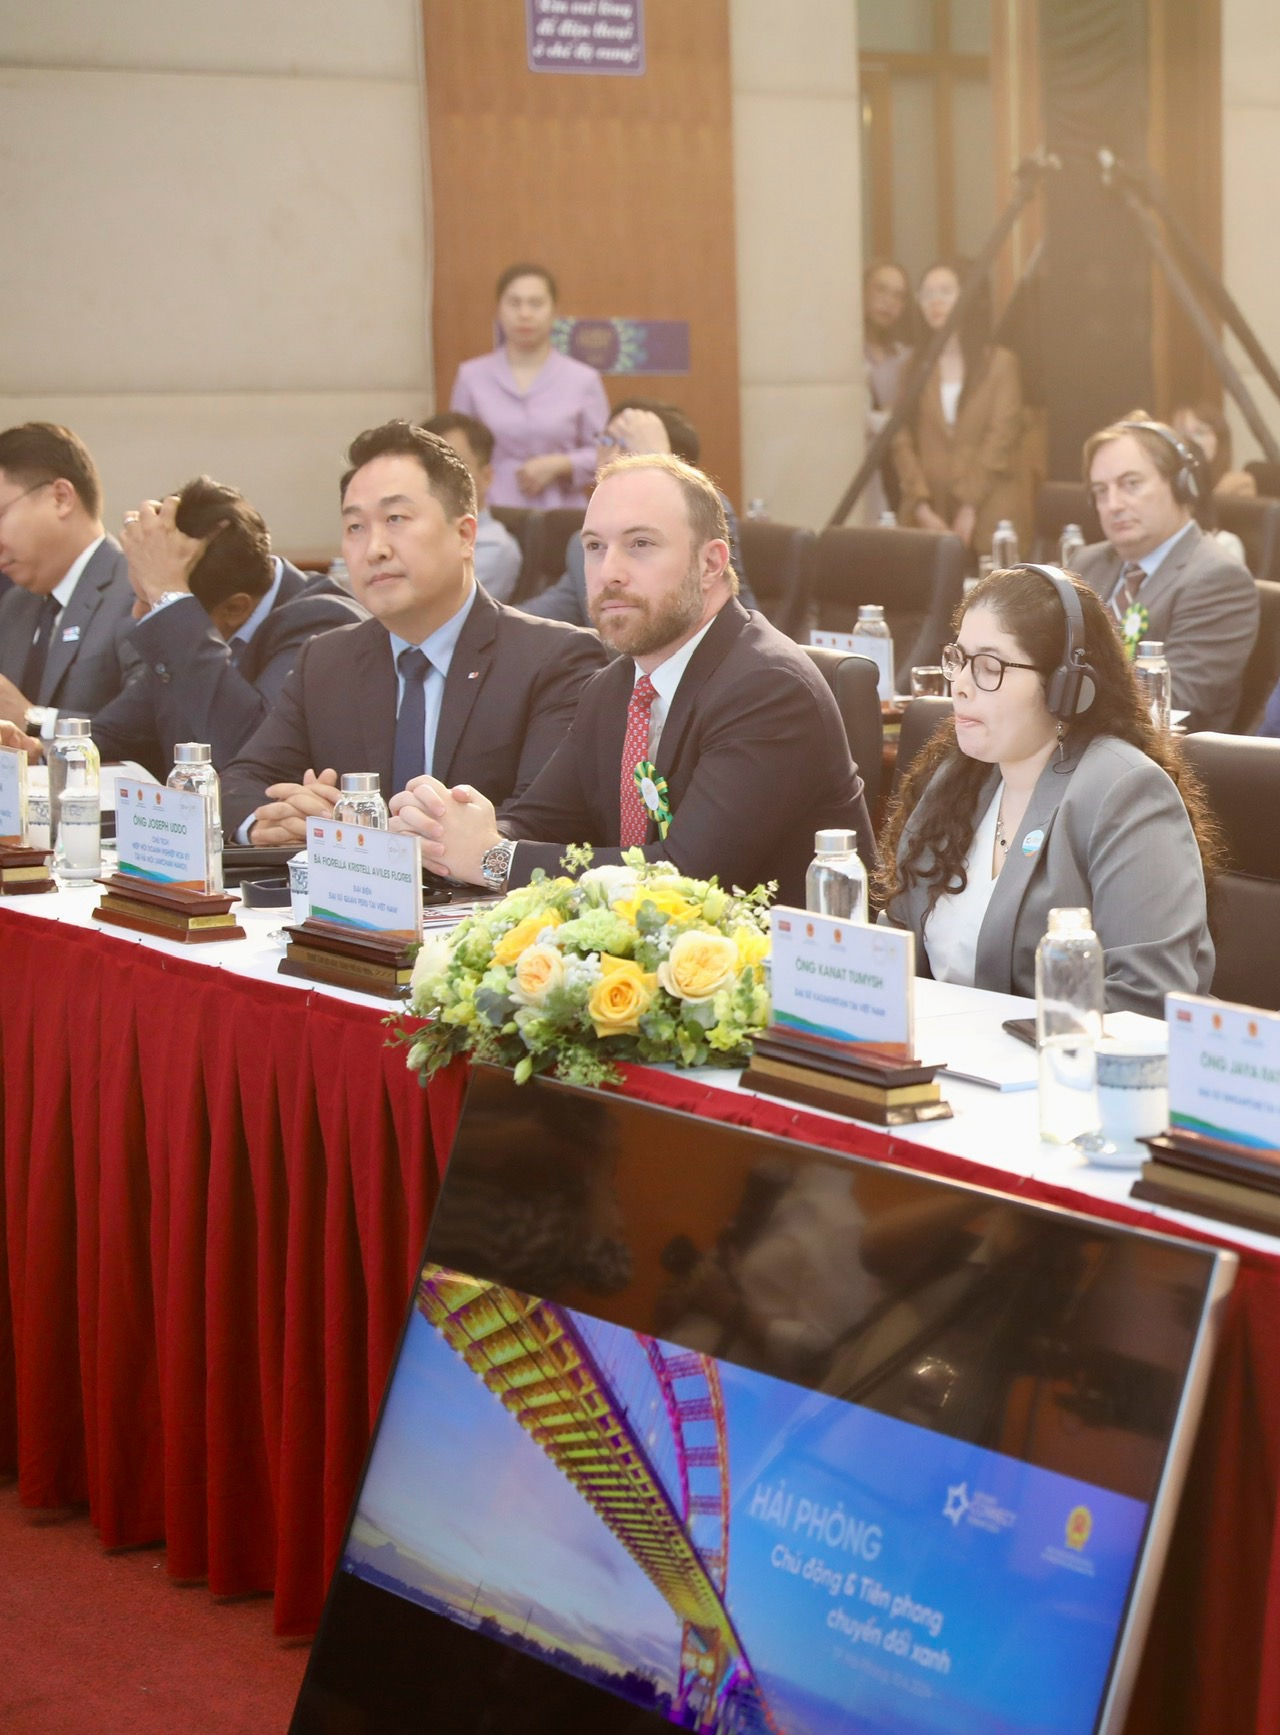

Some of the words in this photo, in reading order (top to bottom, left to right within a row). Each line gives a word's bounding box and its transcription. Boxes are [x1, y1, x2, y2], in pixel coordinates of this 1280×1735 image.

[133, 814, 146, 828] ÔNG
[148, 818, 169, 831] JOSEPH
[170, 822, 188, 835] UDDO
[322, 856, 347, 870] FIORELLA
[348, 862, 370, 876] KRISTELL
[372, 868, 390, 880] AVILES
[391, 871, 412, 884] FLORES
[795, 956, 816, 974] ÔNG
[818, 965, 846, 982] KANAT
[748, 1479, 794, 1530] HẢI
[790, 1501, 884, 1562] PHÒNG
[802, 1558, 843, 1598] động
[843, 1573, 857, 1595] &
[890, 1594, 945, 1638] phong
[826, 1606, 882, 1646] chuyển
[910, 1643, 952, 1674] xanh
